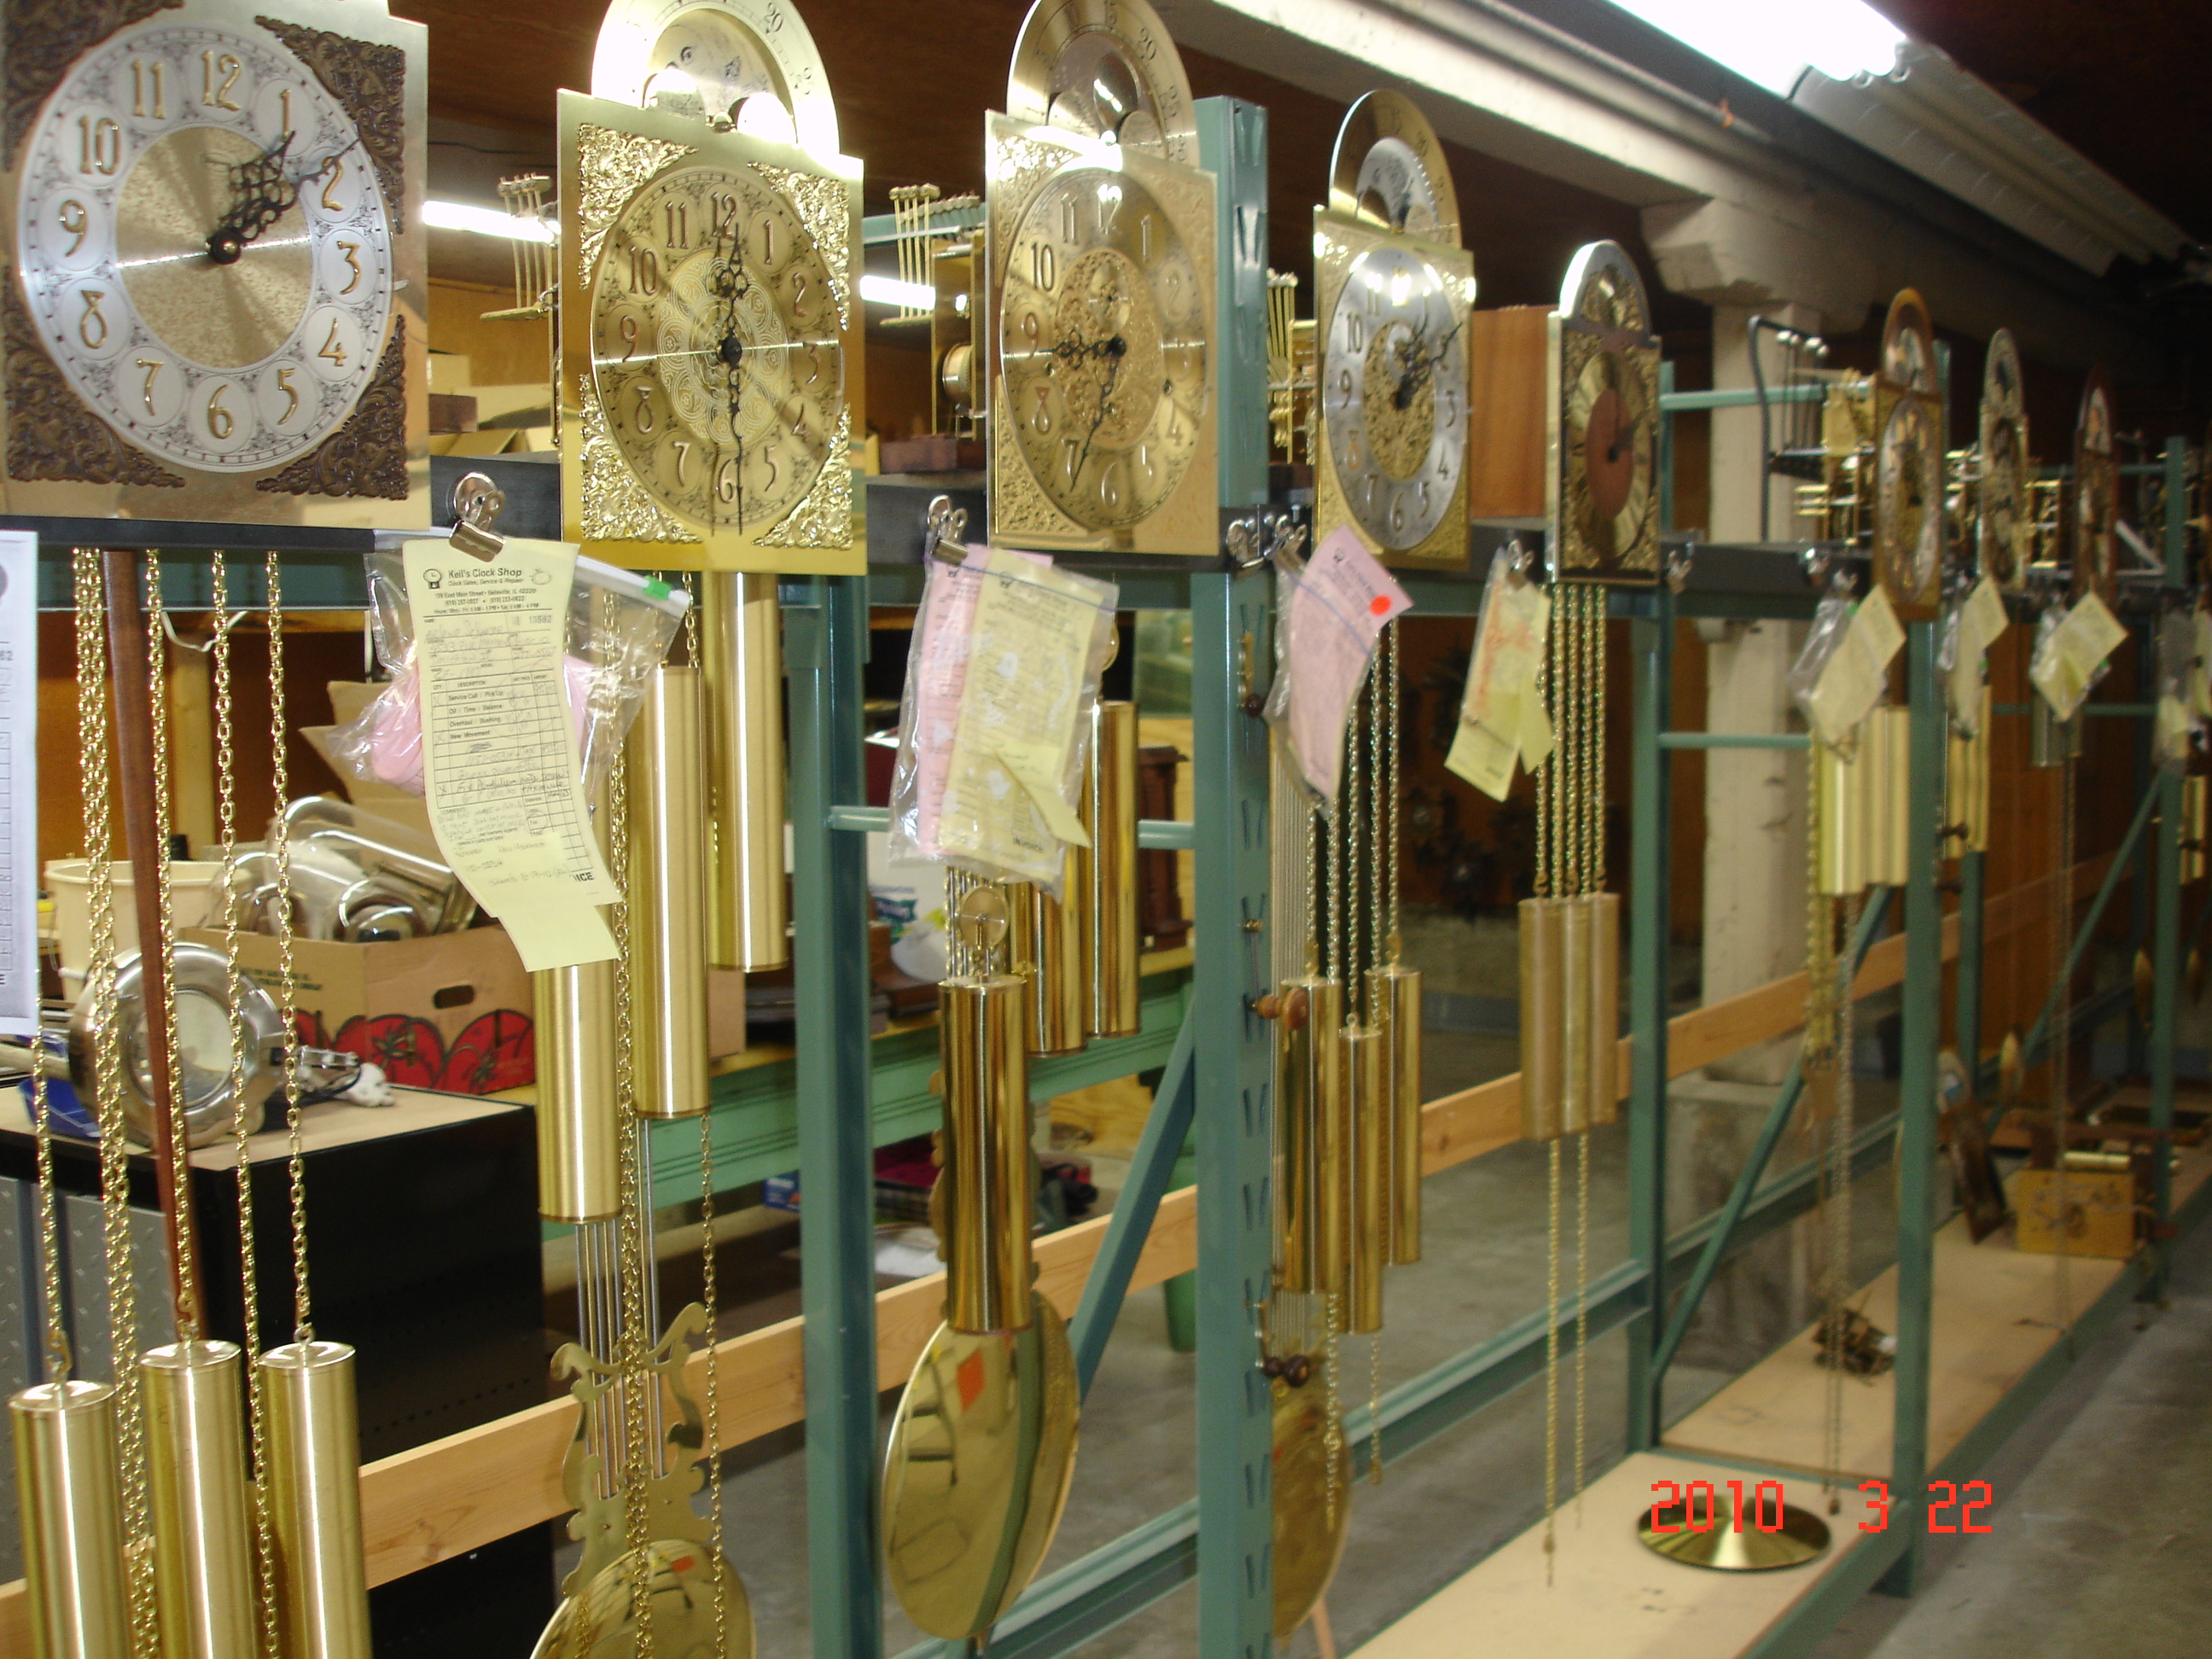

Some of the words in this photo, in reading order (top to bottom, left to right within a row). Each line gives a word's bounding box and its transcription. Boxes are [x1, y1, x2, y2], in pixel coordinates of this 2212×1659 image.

[131, 59, 166, 119] 11
[201, 49, 242, 112] 12
[280, 89, 292, 140] 1
[78, 114, 121, 176] 10
[320, 156, 345, 212] 2
[59, 200, 85, 257] 9
[665, 201, 689, 250] 11
[711, 193, 737, 241] 12
[1059, 195, 1079, 246] 11
[763, 219, 773, 265] 1
[335, 241, 362, 296] 3
[628, 247, 658, 296] 10
[1030, 241, 1056, 292] 10
[793, 271, 808, 319] 2
[79, 290, 108, 349] 8
[317, 317, 348, 367] 4
[620, 316, 638, 362] 9
[1024, 311, 1039, 359] 9
[1346, 312, 1365, 355] 10
[136, 358, 165, 417] 7
[803, 342, 822, 385] 3
[207, 384, 234, 440] 6
[277, 368, 300, 425] 5
[634, 386, 655, 434] 8
[1031, 385, 1051, 434] 8
[1338, 368, 1353, 410] 9
[1443, 390, 1456, 428] 3
[791, 402, 811, 443] 4
[1167, 399, 1182, 447] 4
[672, 441, 690, 488] 7
[719, 458, 739, 504] 6
[764, 445, 778, 492] 5
[1062, 438, 1081, 489] 7
[1100, 462, 1118, 509] 6
[1437, 448, 1450, 480] 4
[1365, 473, 1378, 514] 7
[1390, 493, 1405, 533] 6
[1419, 482, 1431, 520] 5
[448, 569, 470, 579] Keil's
[472, 568, 495, 578] Clock
[497, 568, 522, 579] Shop
[448, 692, 468, 702] Service
[469, 691, 478, 700] Call
[463, 730, 491, 739] Movement
[479, 717, 501, 725] Bushing
[574, 872, 594, 882] ICE
